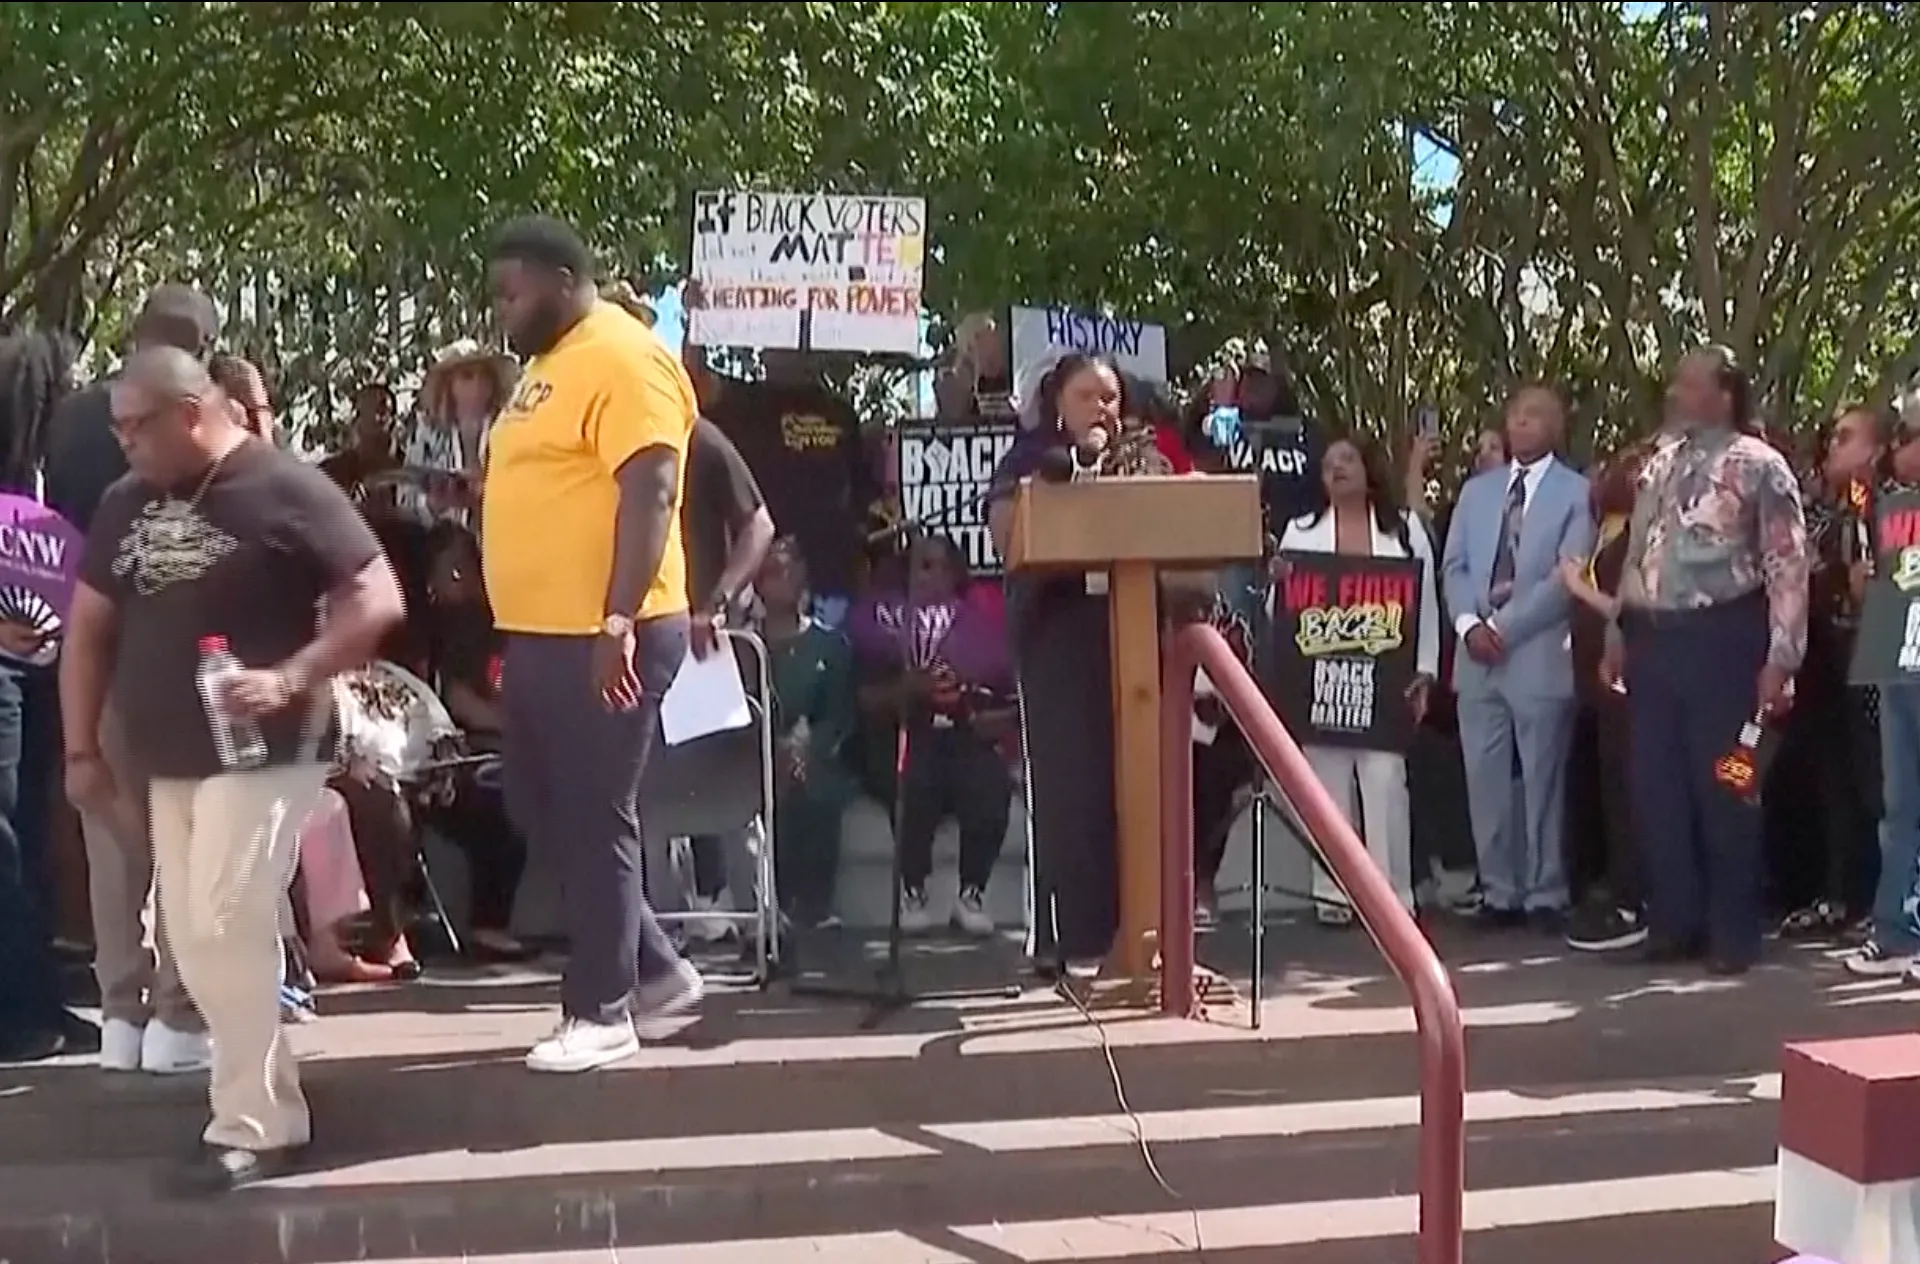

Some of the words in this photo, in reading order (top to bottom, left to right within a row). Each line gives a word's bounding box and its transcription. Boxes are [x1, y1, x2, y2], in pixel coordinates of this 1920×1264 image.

[747, 194, 816, 234] BLACK
[825, 197, 920, 236] VOTERS
[698, 286, 797, 311] HEATING
[1046, 305, 1143, 357] HISTORY
[1285, 573, 1327, 611] WE
